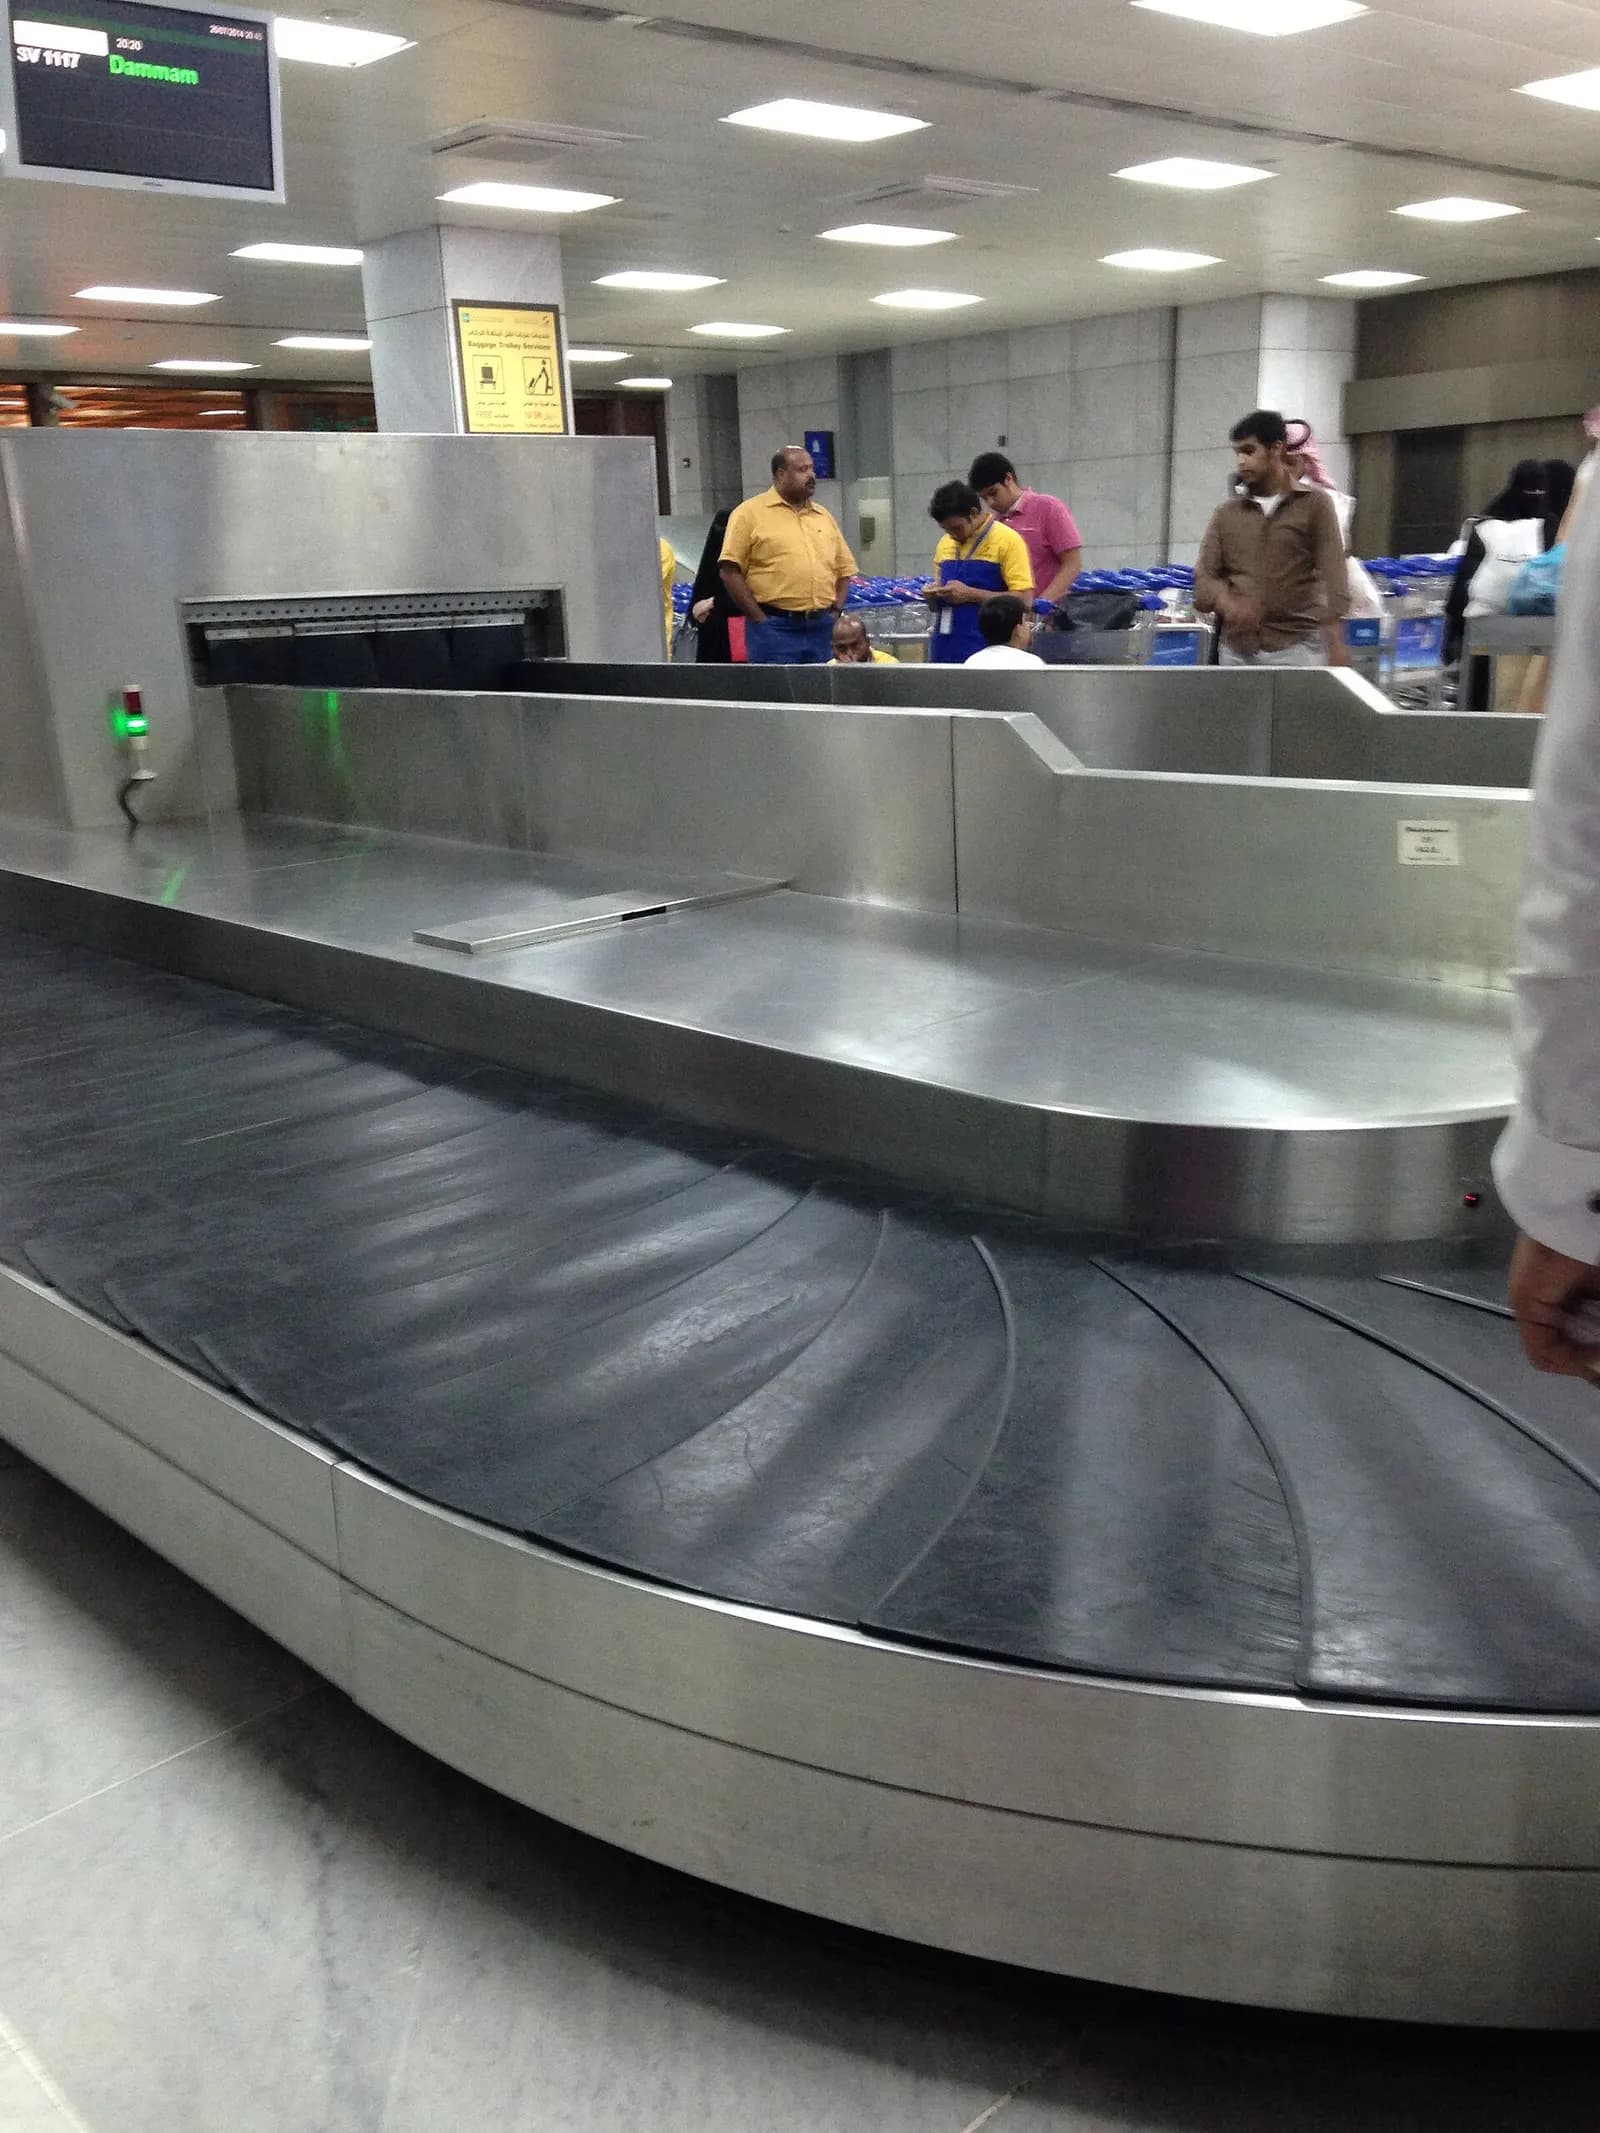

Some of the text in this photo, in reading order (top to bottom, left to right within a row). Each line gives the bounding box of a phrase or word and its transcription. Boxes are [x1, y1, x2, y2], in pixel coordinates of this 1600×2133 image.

[116, 38, 142, 50] 20:20
[16, 46, 80, 69] SV 1117
[109, 54, 199, 85] Dammam
[468, 340, 497, 349] Baggage
